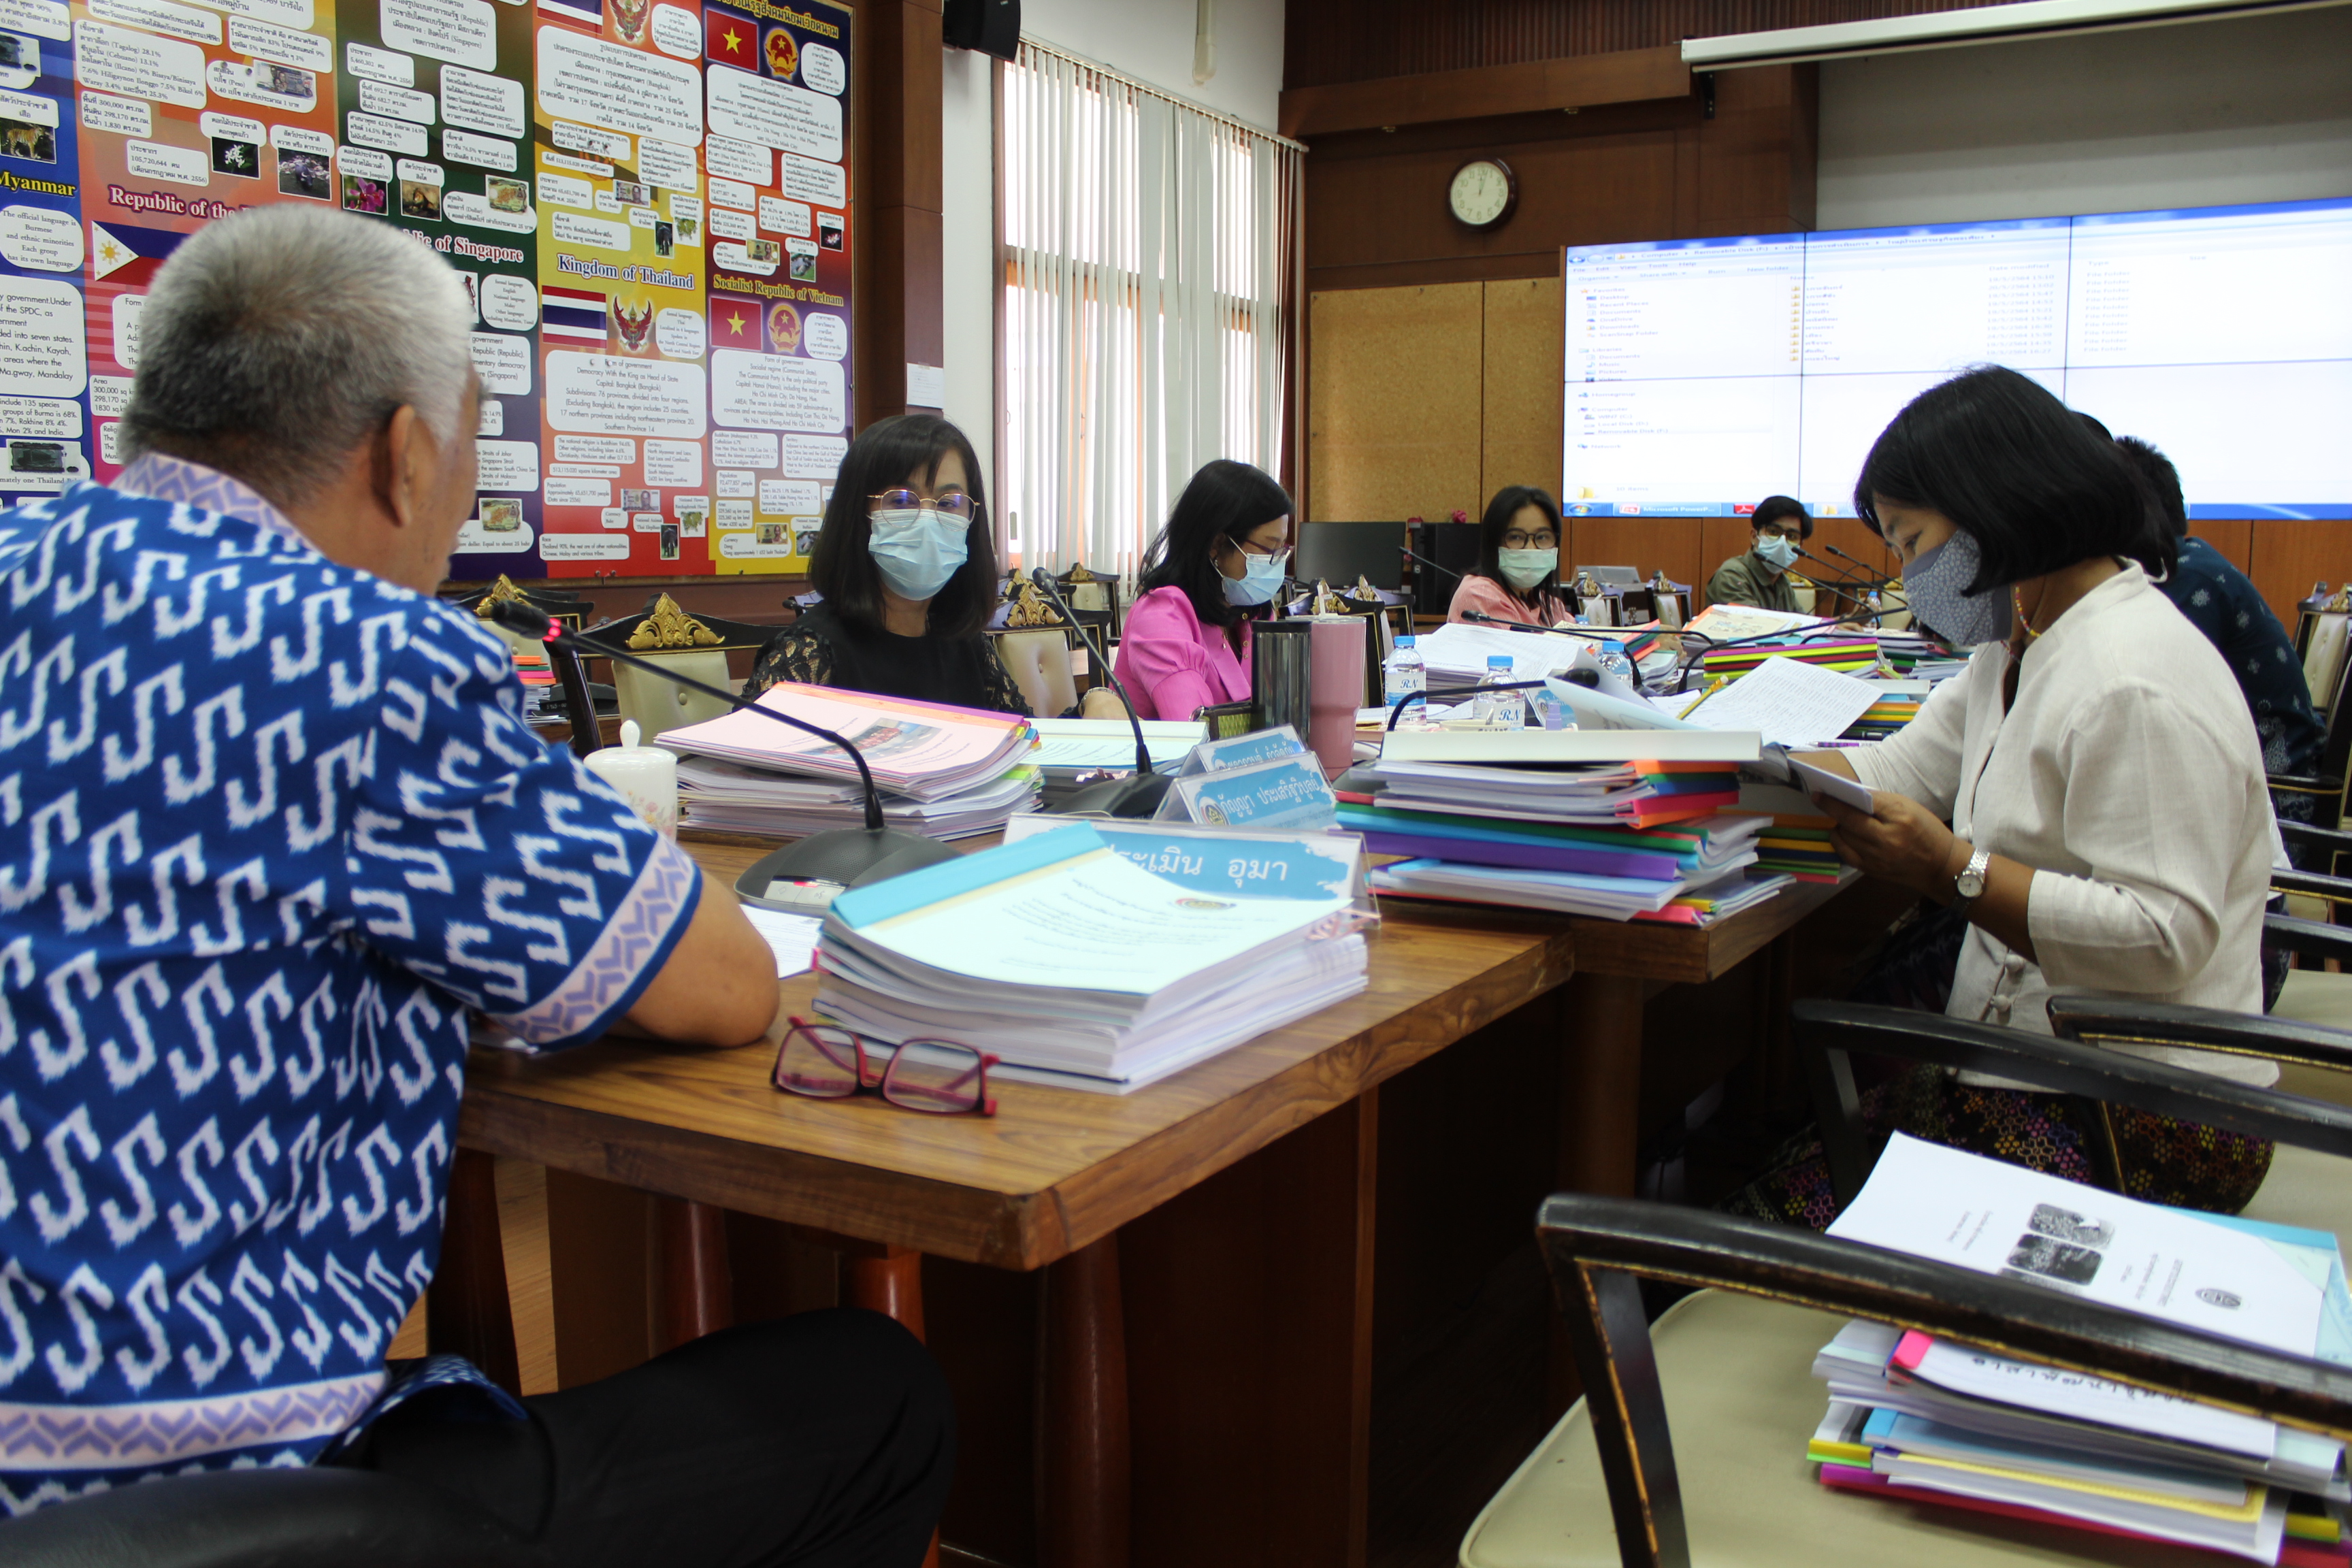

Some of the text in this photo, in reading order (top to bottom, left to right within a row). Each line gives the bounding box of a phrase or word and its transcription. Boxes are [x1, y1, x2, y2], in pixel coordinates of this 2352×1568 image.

[36, 5, 52, 14] 90%
[1, 18, 23, 28] 0.05%
[52, 18, 69, 28] 3.8%
[111, 41, 161, 59] (Tagalog) 28.1%
[106, 50, 159, 67] (Cebuano) 13.1%
[82, 67, 99, 76] 7.6%
[101, 70, 135, 83] Hiligaynon
[136, 77, 159, 88] Ilonggo
[161, 82, 176, 91] 7.5%
[178, 85, 193, 95] Bikol
[139, 67, 150, 76] 9%
[151, 70, 196, 86] Bisaya/Binisaya
[82, 76, 168, 100] Waray 3.4% 25.3%
[99, 99, 124, 110] 300,000
[104, 111, 129, 121] 298,170
[104, 121, 121, 130] 1,830
[131, 155, 167, 167] 105,720,644
[0, 171, 76, 197] Myanmar
[191, 175, 208, 184] 2556)
[110, 186, 184, 213] Republic
[191, 201, 208, 216] of
[3, 210, 15, 218] The
[18, 212, 39, 221] official
[42, 215, 69, 226] language
[25, 224, 52, 233] Burmese
[20, 234, 40, 243] ethnic
[43, 236, 74, 246] minorities
[22, 245, 59, 256] Each group
[436, 235, 451, 252] of
[455, 237, 524, 263] Singapore
[1641, 250, 1679, 259] Computer
[1694, 246, 1736, 255] Removable
[46, 259, 76, 268] language.
[558, 255, 694, 289] Kingdom of Thailand
[1578, 274, 1610, 282] Organize
[714, 275, 845, 306] Socialist Republic of Vietnam
[7, 295, 71, 308] government.Under
[125, 298, 142, 306] Form
[6, 306, 17, 314] the
[20, 308, 42, 317] SPDC,
[53, 335, 74, 343] states.
[47, 346, 71, 356] Kayah,
[472, 346, 525, 358] Republic (Republic).
[497, 361, 526, 370] democracy
[37, 371, 73, 382] Mandalay
[487, 371, 518, 380] (Singapore)
[577, 368, 604, 376] Democracy
[647, 373, 659, 381] Head
[94, 387, 118, 395] 300,000
[596, 380, 661, 392] Capital: Bangkok (Bangkok)
[94, 395, 118, 404] 298,170
[566, 388, 597, 397] Subdivisions:
[632, 393, 649, 401] divided
[39, 401, 60, 409] species
[3, 410, 23, 418] groups
[591, 412, 613, 421] provinces
[615, 413, 636, 423] including
[638, 415, 666, 423] northeastern
[667, 417, 686, 425] province
[604, 423, 625, 431] Southern
[1400, 679, 1418, 689] RN
[1499, 708, 1520, 721] RN
[1228, 859, 1288, 887] อุมา
